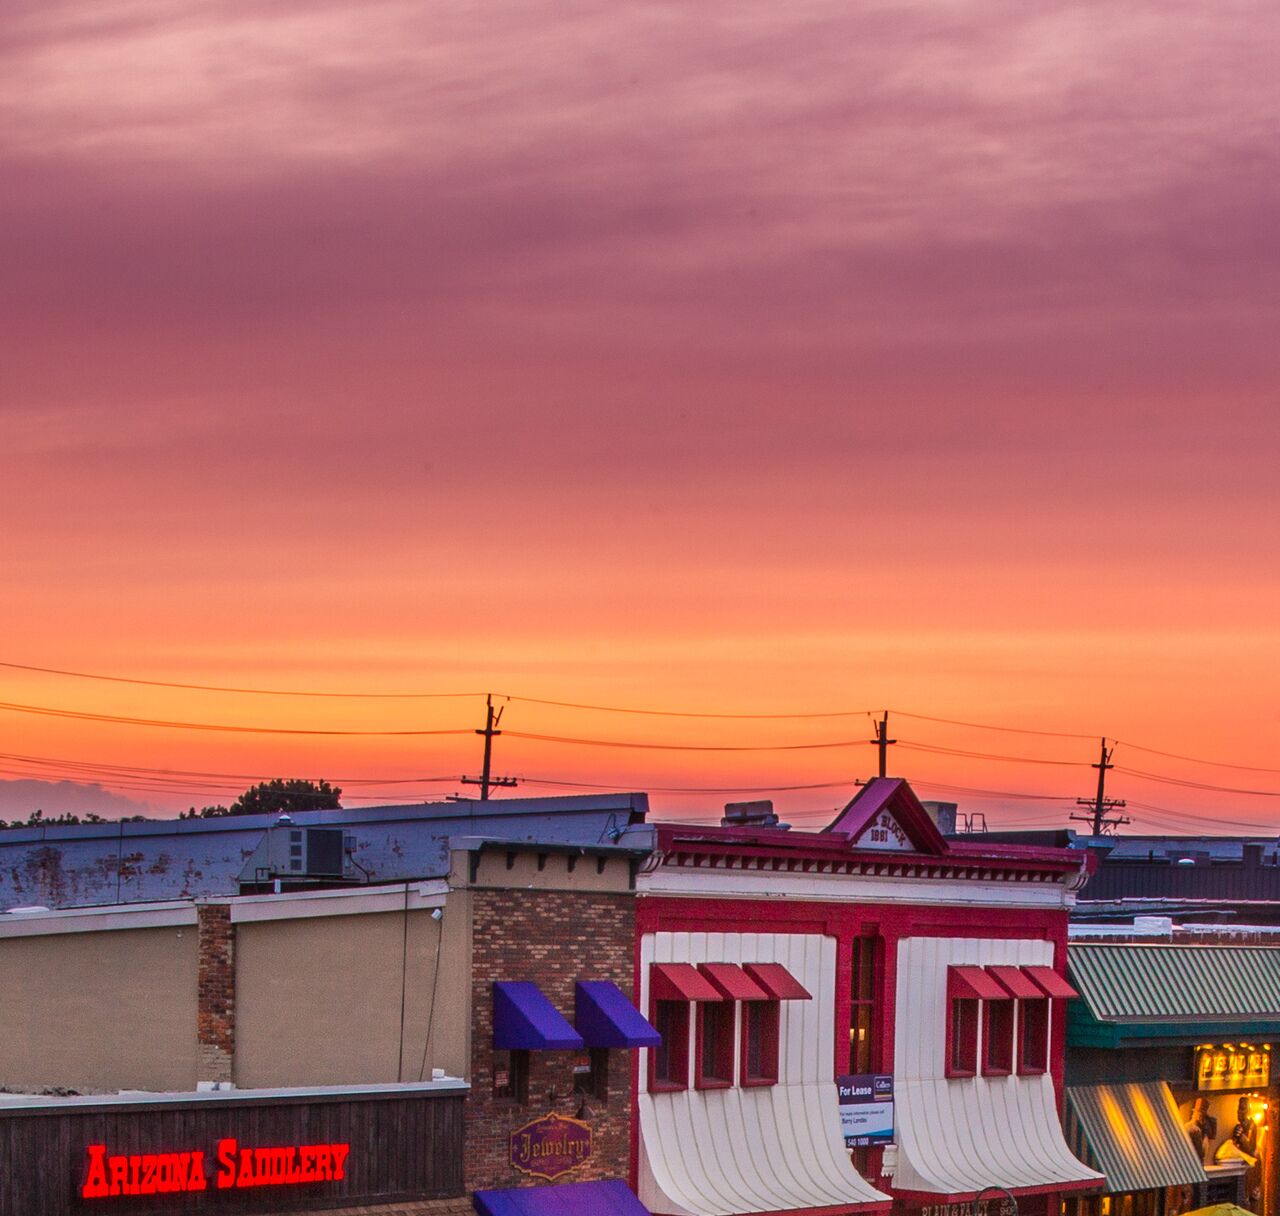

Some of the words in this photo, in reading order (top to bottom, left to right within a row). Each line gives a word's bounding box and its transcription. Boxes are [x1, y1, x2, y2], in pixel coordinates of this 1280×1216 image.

[840, 1086, 851, 1096] For
[852, 1085, 872, 1095] Lease
[520, 1133, 584, 1162] Jewelry
[82, 1144, 206, 1198] ARIZONA
[218, 1138, 349, 1188] SADDLERY
